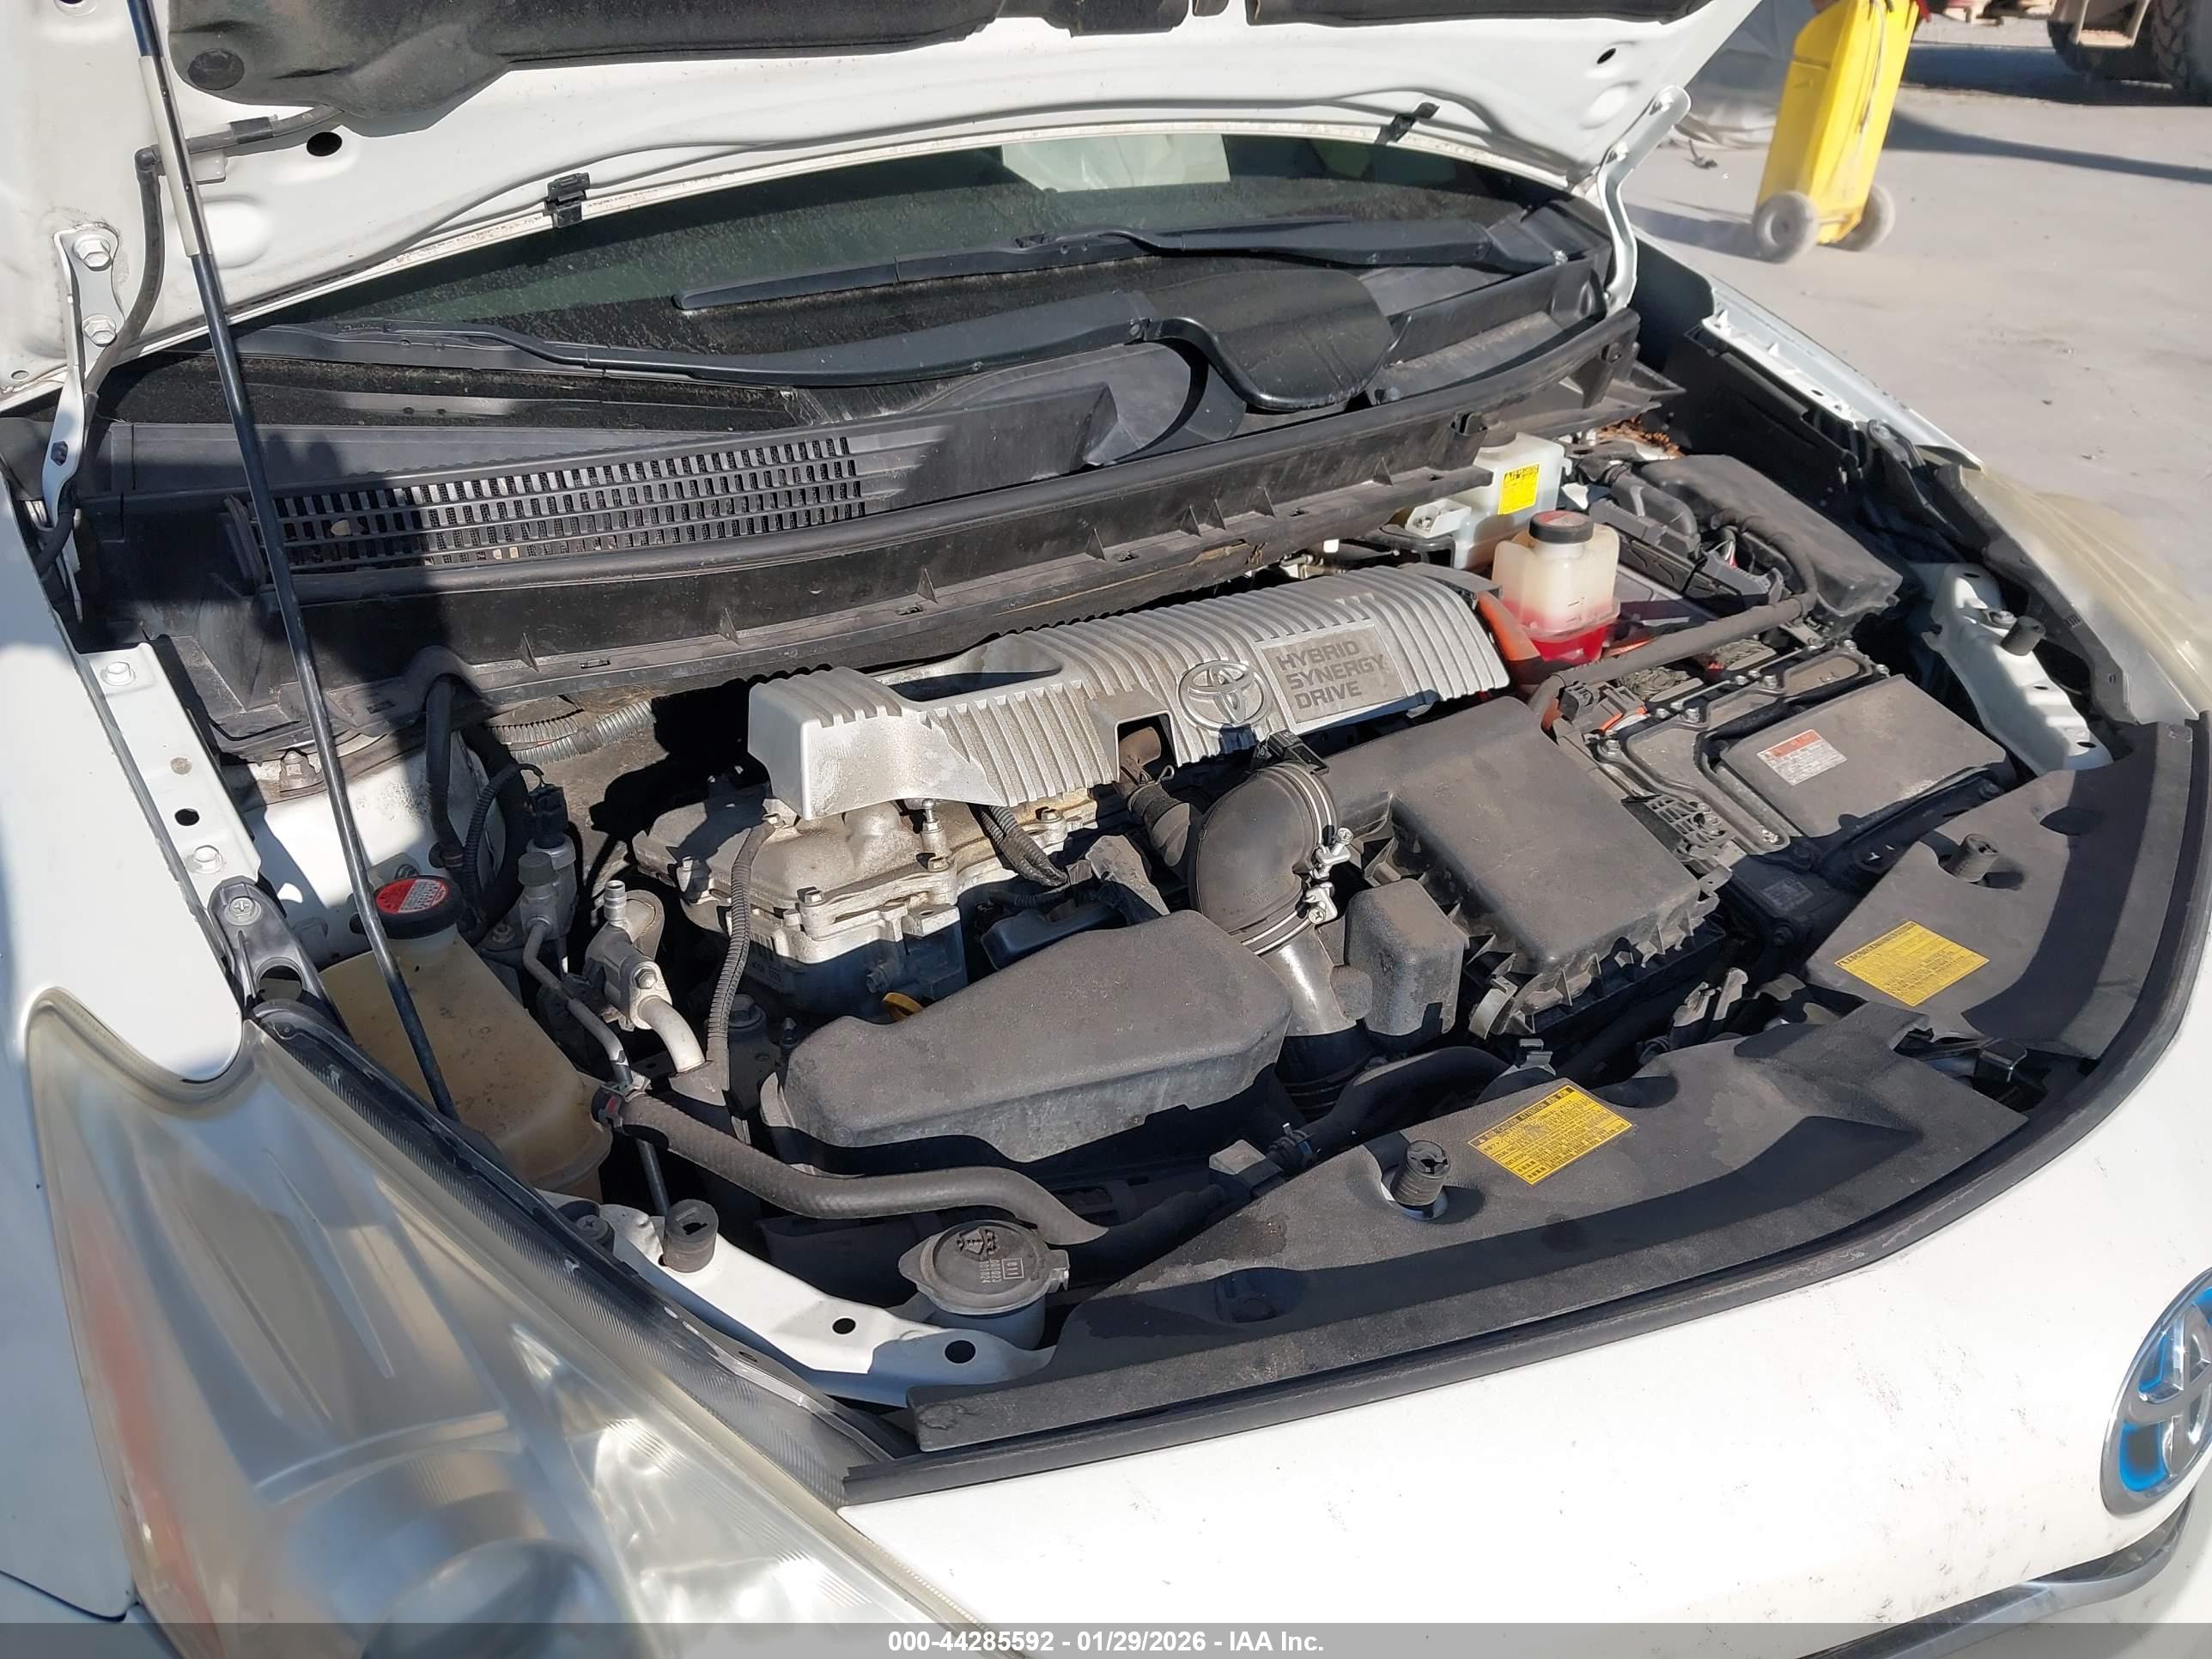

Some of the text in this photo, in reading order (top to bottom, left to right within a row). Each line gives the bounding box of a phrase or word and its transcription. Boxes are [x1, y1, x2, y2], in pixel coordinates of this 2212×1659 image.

[1277, 641, 1359, 671] HYBRID
[1285, 654, 1385, 690] SYNERGY
[1293, 681, 1363, 710] DRIVE
